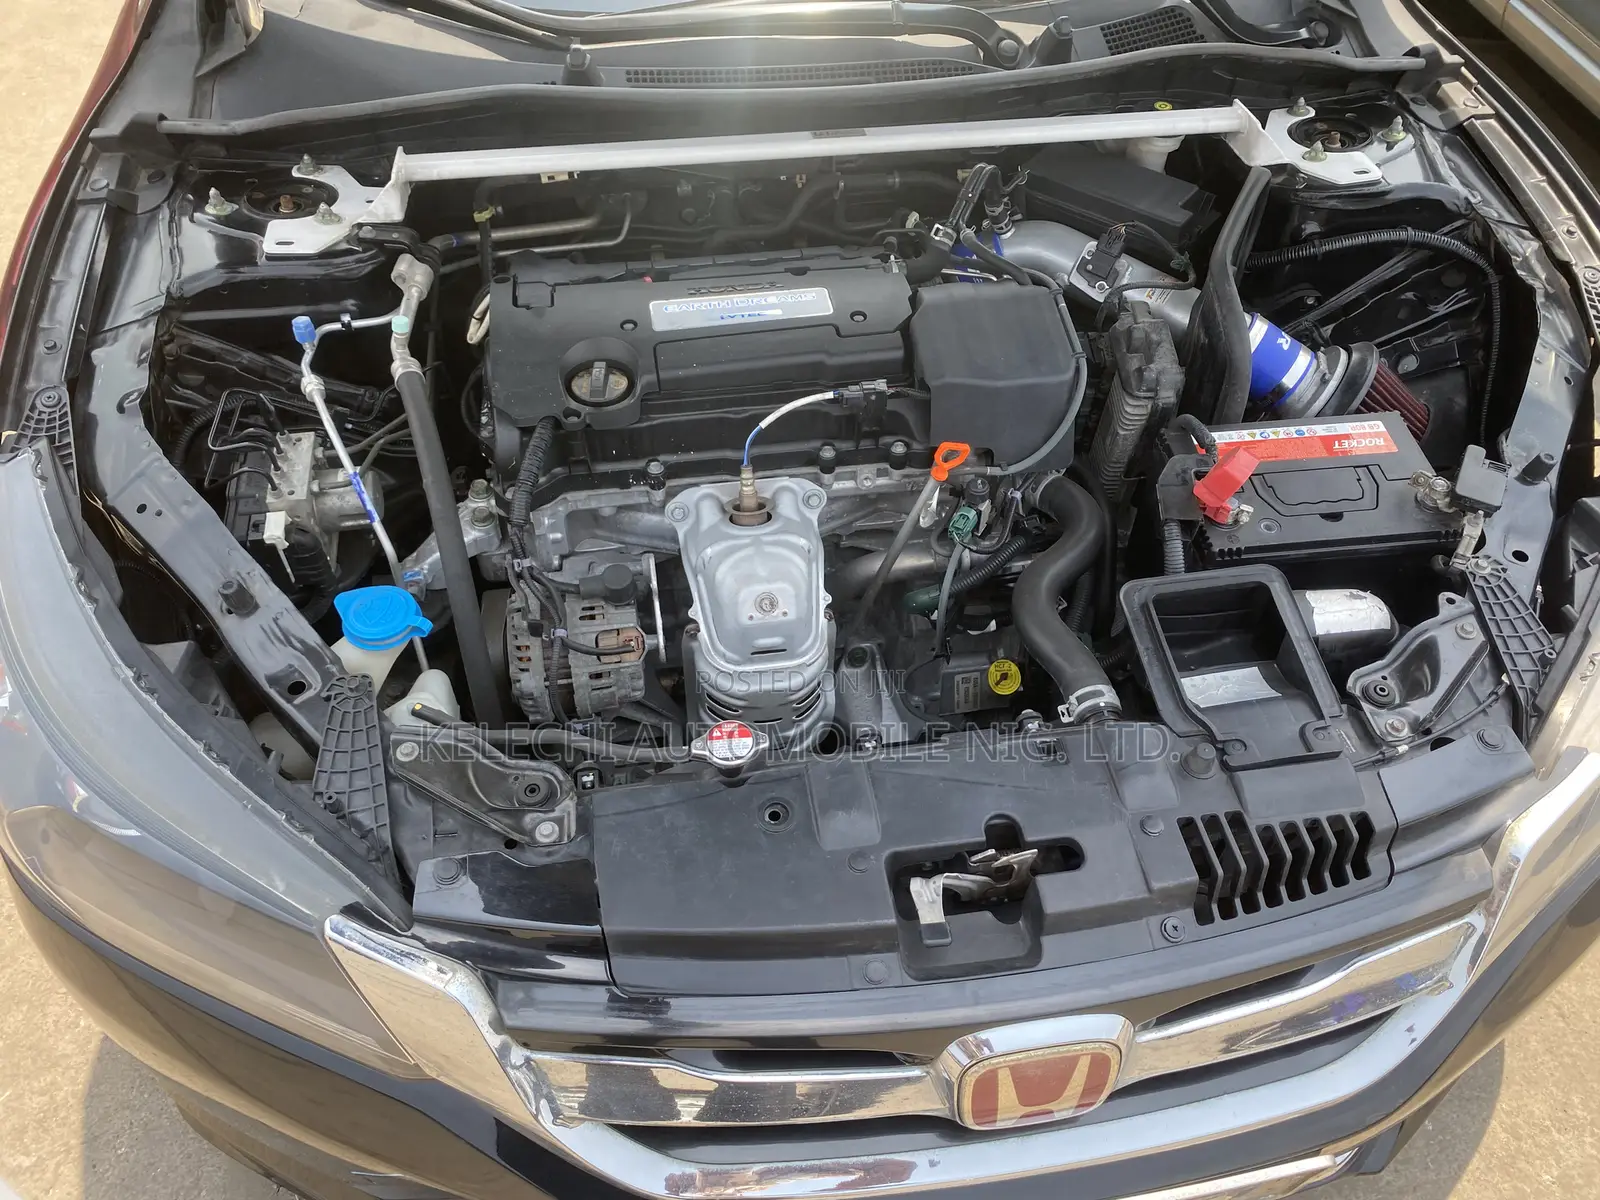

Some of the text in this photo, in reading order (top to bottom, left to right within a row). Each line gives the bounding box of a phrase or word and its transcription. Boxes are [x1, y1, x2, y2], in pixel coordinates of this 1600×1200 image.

[663, 291, 817, 313] EARTH DREAMS
[1333, 437, 1385, 449] ROCKET
